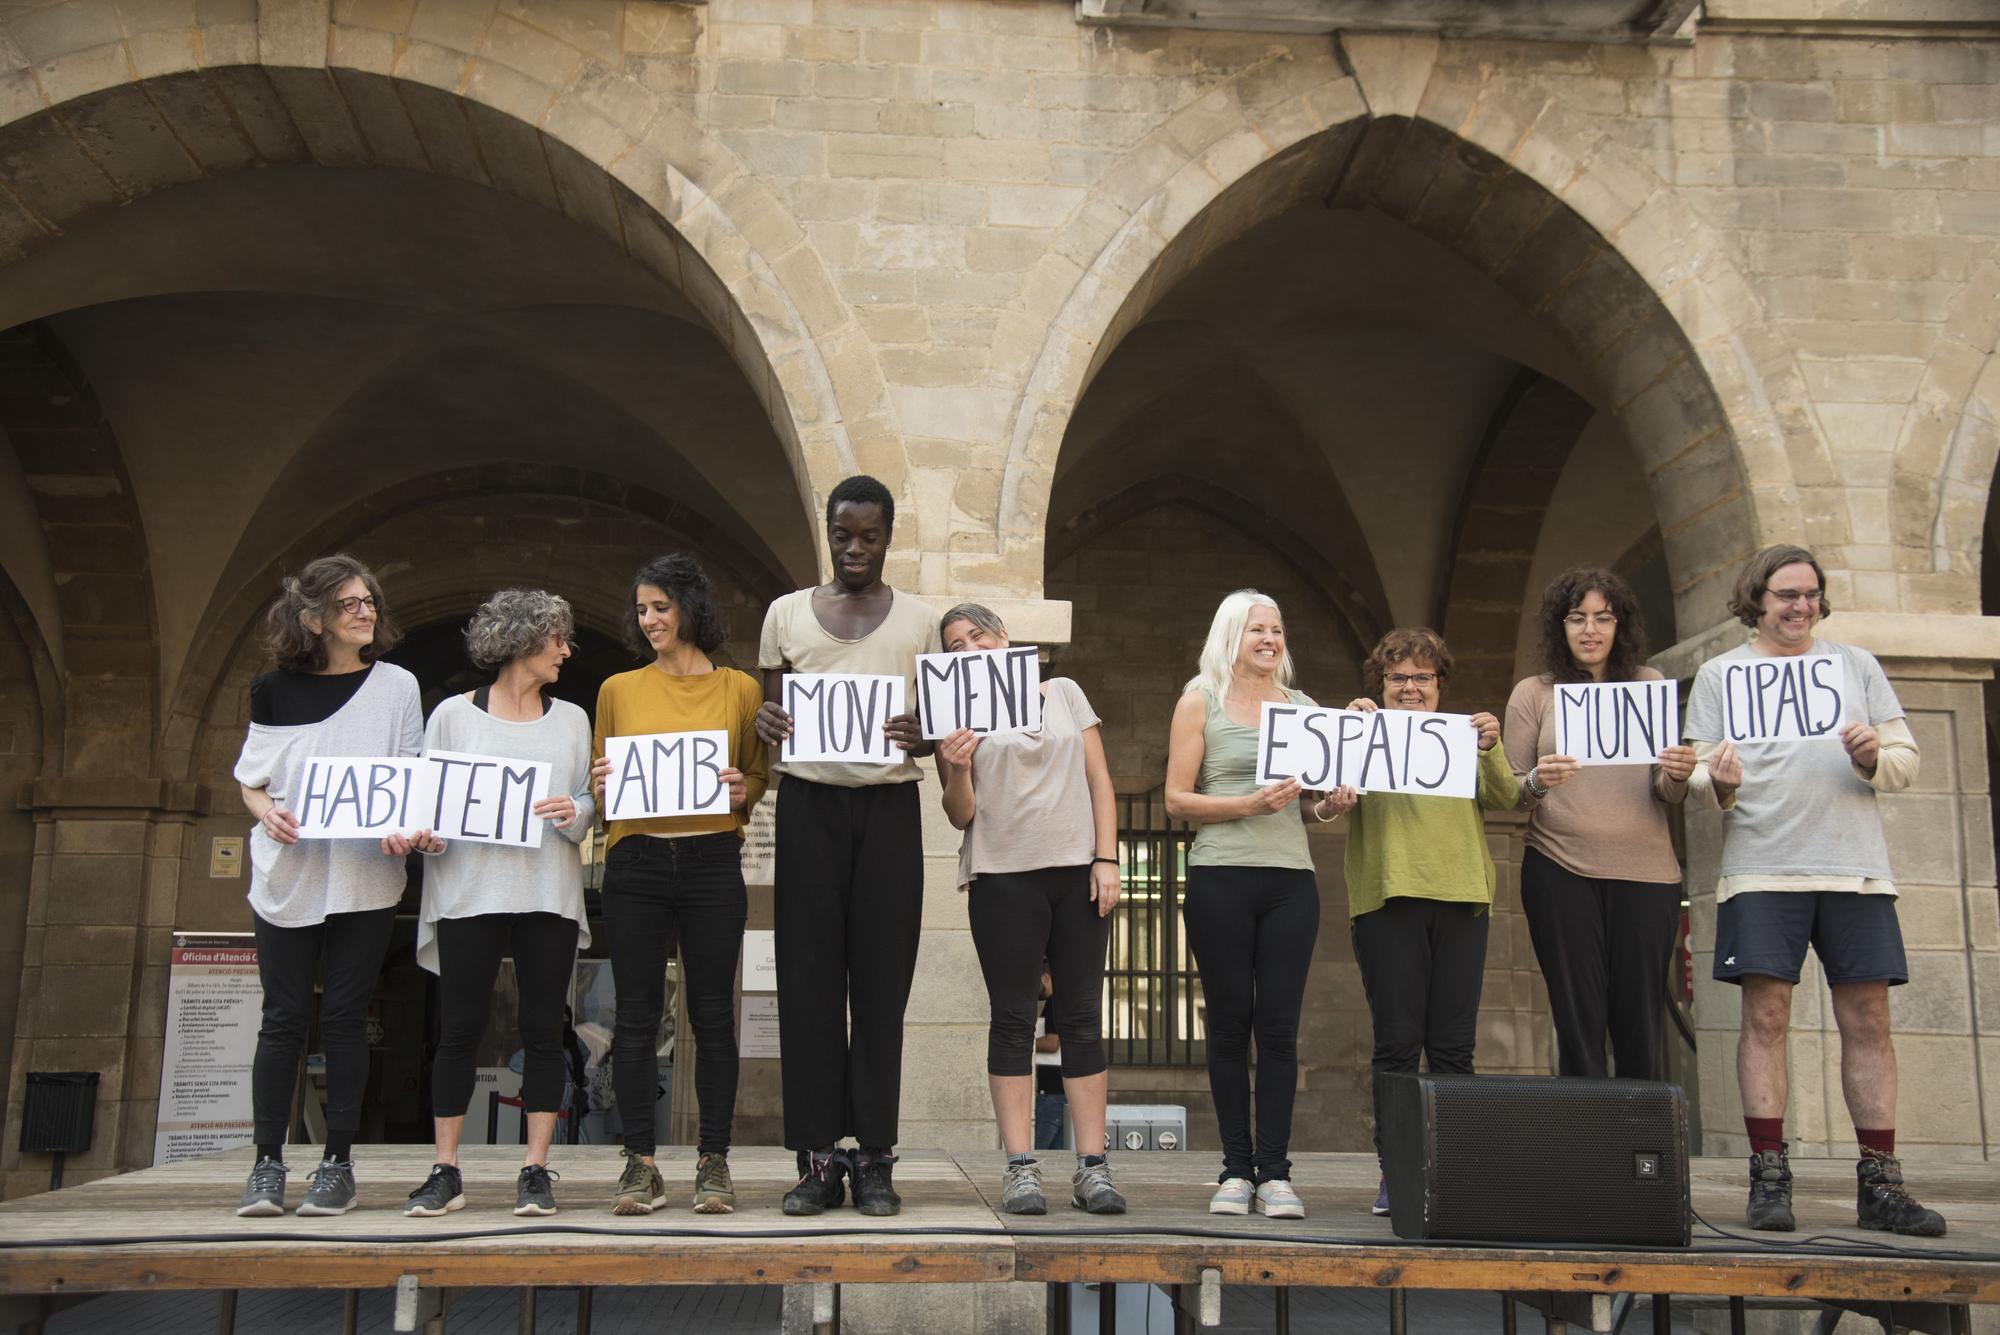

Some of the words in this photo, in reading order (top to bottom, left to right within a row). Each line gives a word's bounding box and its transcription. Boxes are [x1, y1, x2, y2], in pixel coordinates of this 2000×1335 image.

[787, 678, 893, 758] MOVI
[920, 648, 1039, 734] MENT
[1560, 684, 1668, 759] MUNI
[1726, 658, 1842, 741] CIPAIS
[612, 737, 722, 814] AMB
[182, 952, 212, 962] Oficina
[214, 952, 250, 962] d'Atenció
